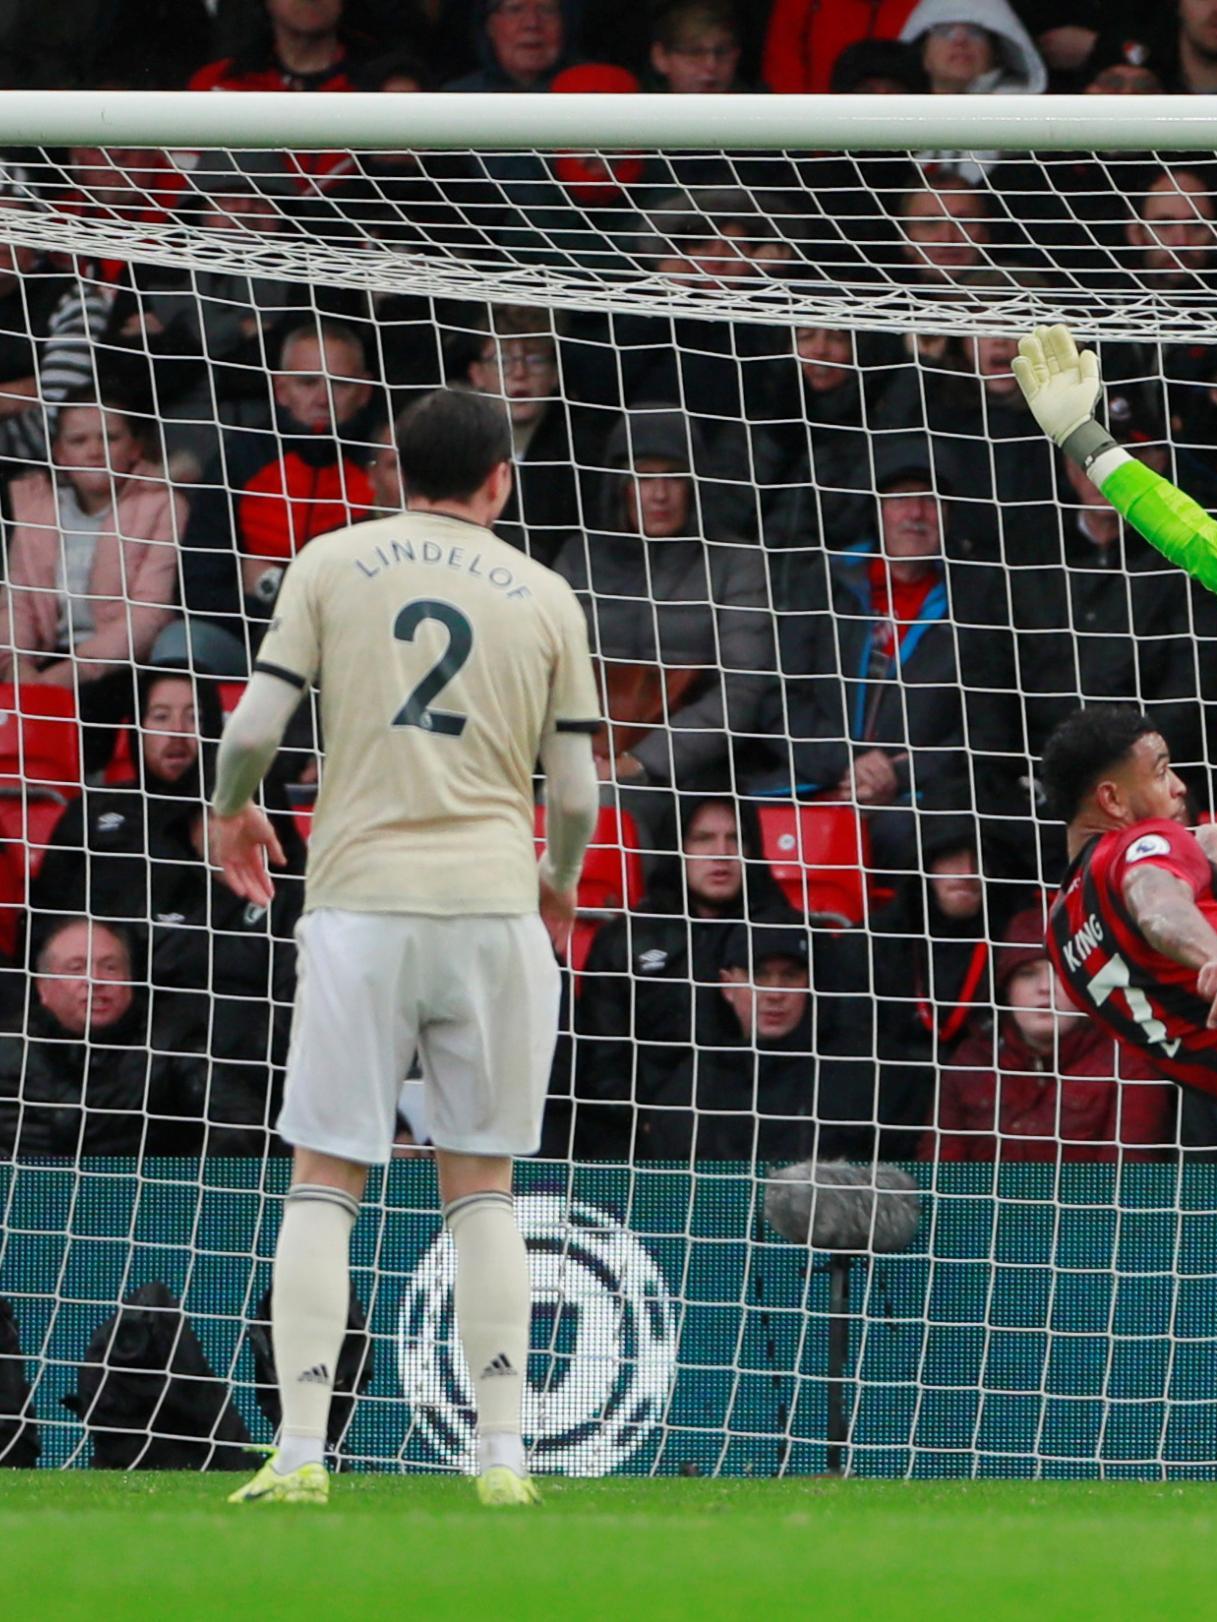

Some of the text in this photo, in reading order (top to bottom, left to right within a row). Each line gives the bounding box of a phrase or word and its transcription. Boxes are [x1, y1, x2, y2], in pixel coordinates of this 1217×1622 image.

[356, 540, 532, 599] LINDELOF
[390, 600, 474, 736] 2
[1063, 914, 1104, 972] KING
[1087, 953, 1182, 1058] 7
